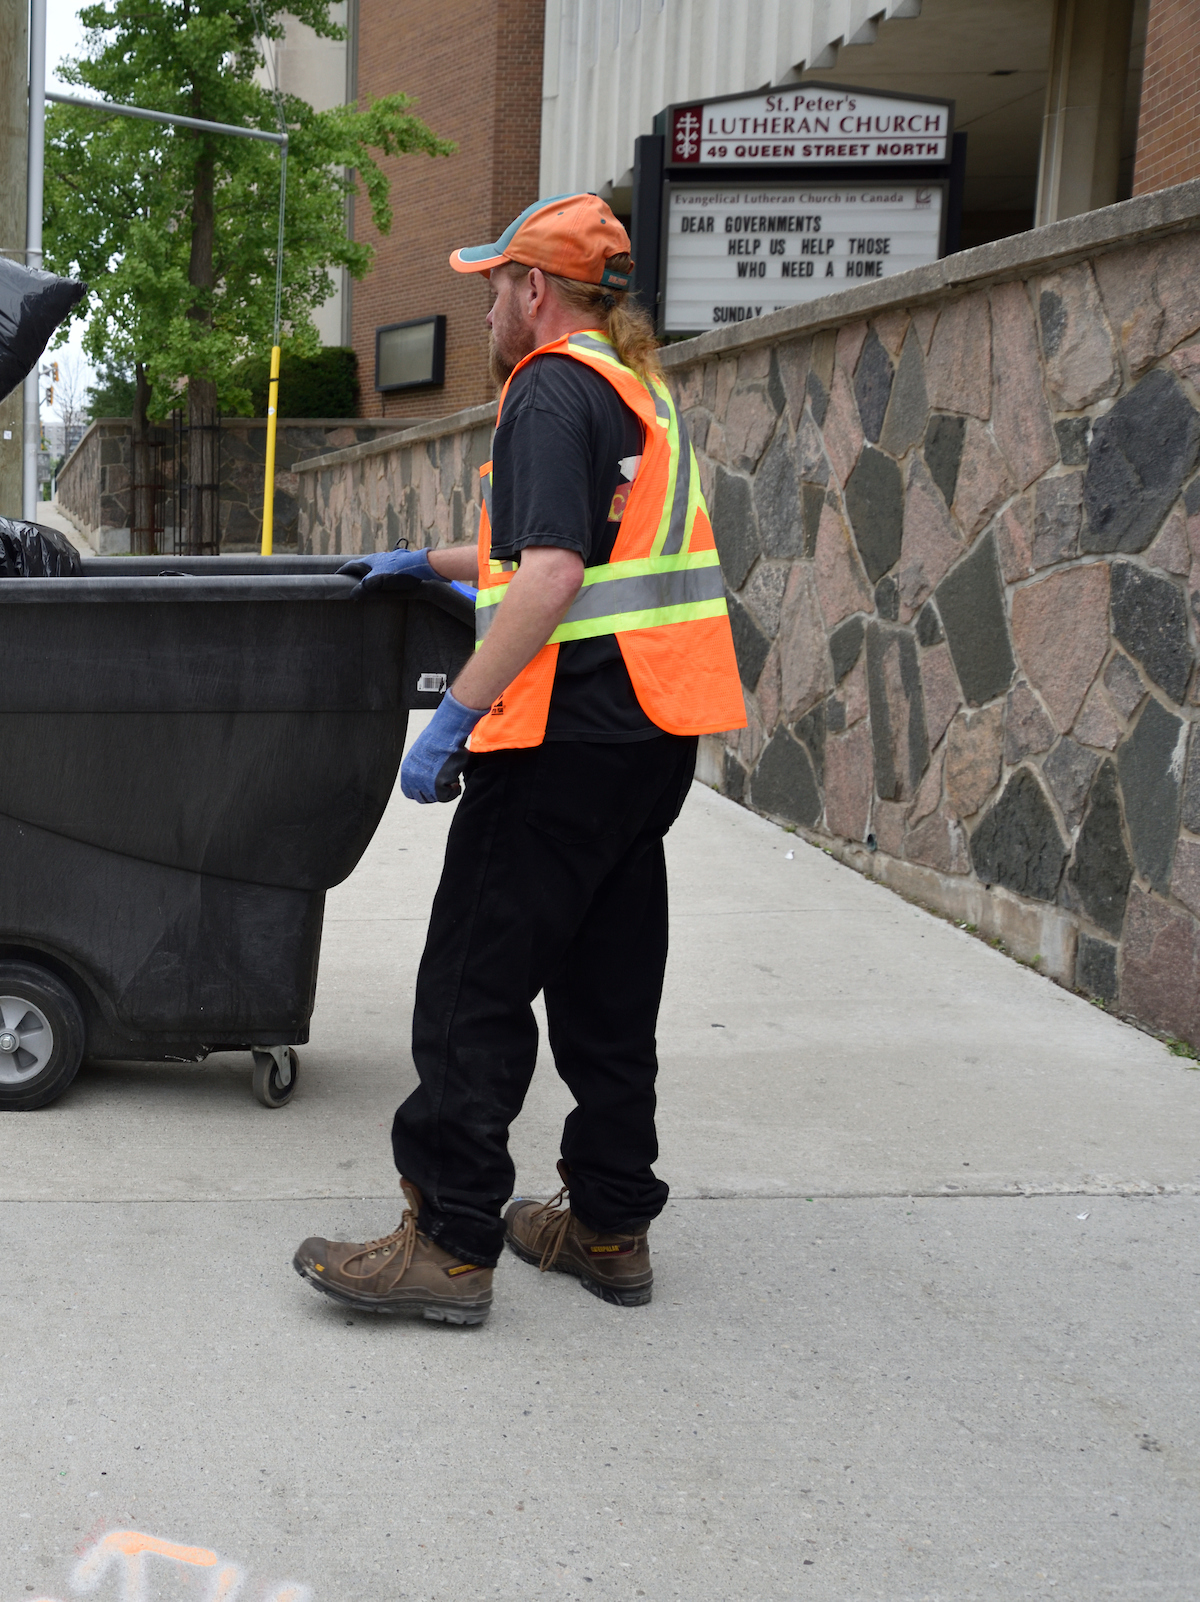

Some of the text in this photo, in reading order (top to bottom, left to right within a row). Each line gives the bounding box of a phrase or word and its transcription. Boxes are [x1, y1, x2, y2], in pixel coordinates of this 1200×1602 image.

[765, 94, 857, 113] St. Peter's
[708, 114, 941, 135] LUTHERAN CHURCH
[707, 142, 939, 158] 49 QUEEN STREET NORTH
[675, 191, 905, 207] Evangelical Lutheran Church in Canada
[681, 215, 822, 234] DEAR GOVERNMENTS
[728, 237, 892, 256] HELP US HELP THOSE
[737, 260, 884, 278] WHO NEED A HOME
[713, 306, 763, 323] SUNDAY
